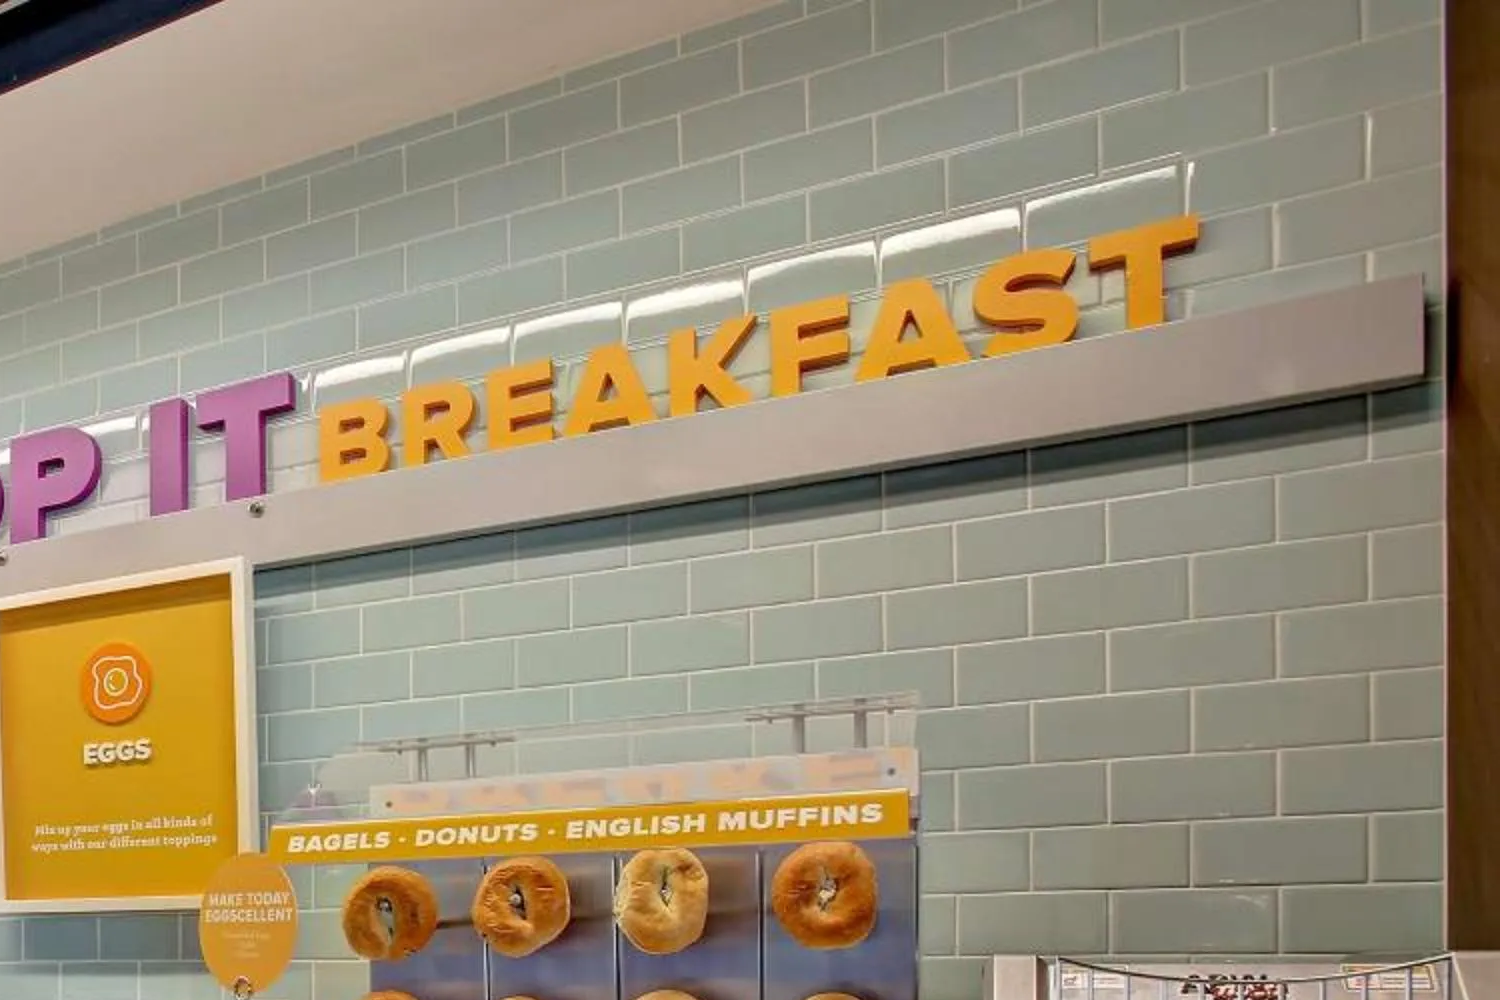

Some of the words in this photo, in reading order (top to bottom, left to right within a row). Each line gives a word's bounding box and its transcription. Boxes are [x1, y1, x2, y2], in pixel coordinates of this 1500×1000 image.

[148, 373, 297, 516] IT
[319, 214, 1199, 482] BREAKFAST
[83, 738, 152, 765] EGGS
[72, 824, 99, 837] your
[101, 822, 129, 834] eggs
[131, 820, 144, 830] in
[145, 818, 162, 829] all
[163, 815, 197, 828] kinds
[199, 813, 213, 826] of
[287, 831, 390, 854] BAGELS
[414, 822, 538, 847] DONUTS
[565, 813, 706, 840] ENGLISH
[717, 802, 884, 831] MUFFINS
[60, 838, 85, 850] with
[109, 836, 161, 849] different
[163, 833, 218, 847] toppings
[209, 893, 243, 907] MAKE
[246, 891, 291, 905] TODAY
[205, 908, 293, 923] EGGSCELLENT
